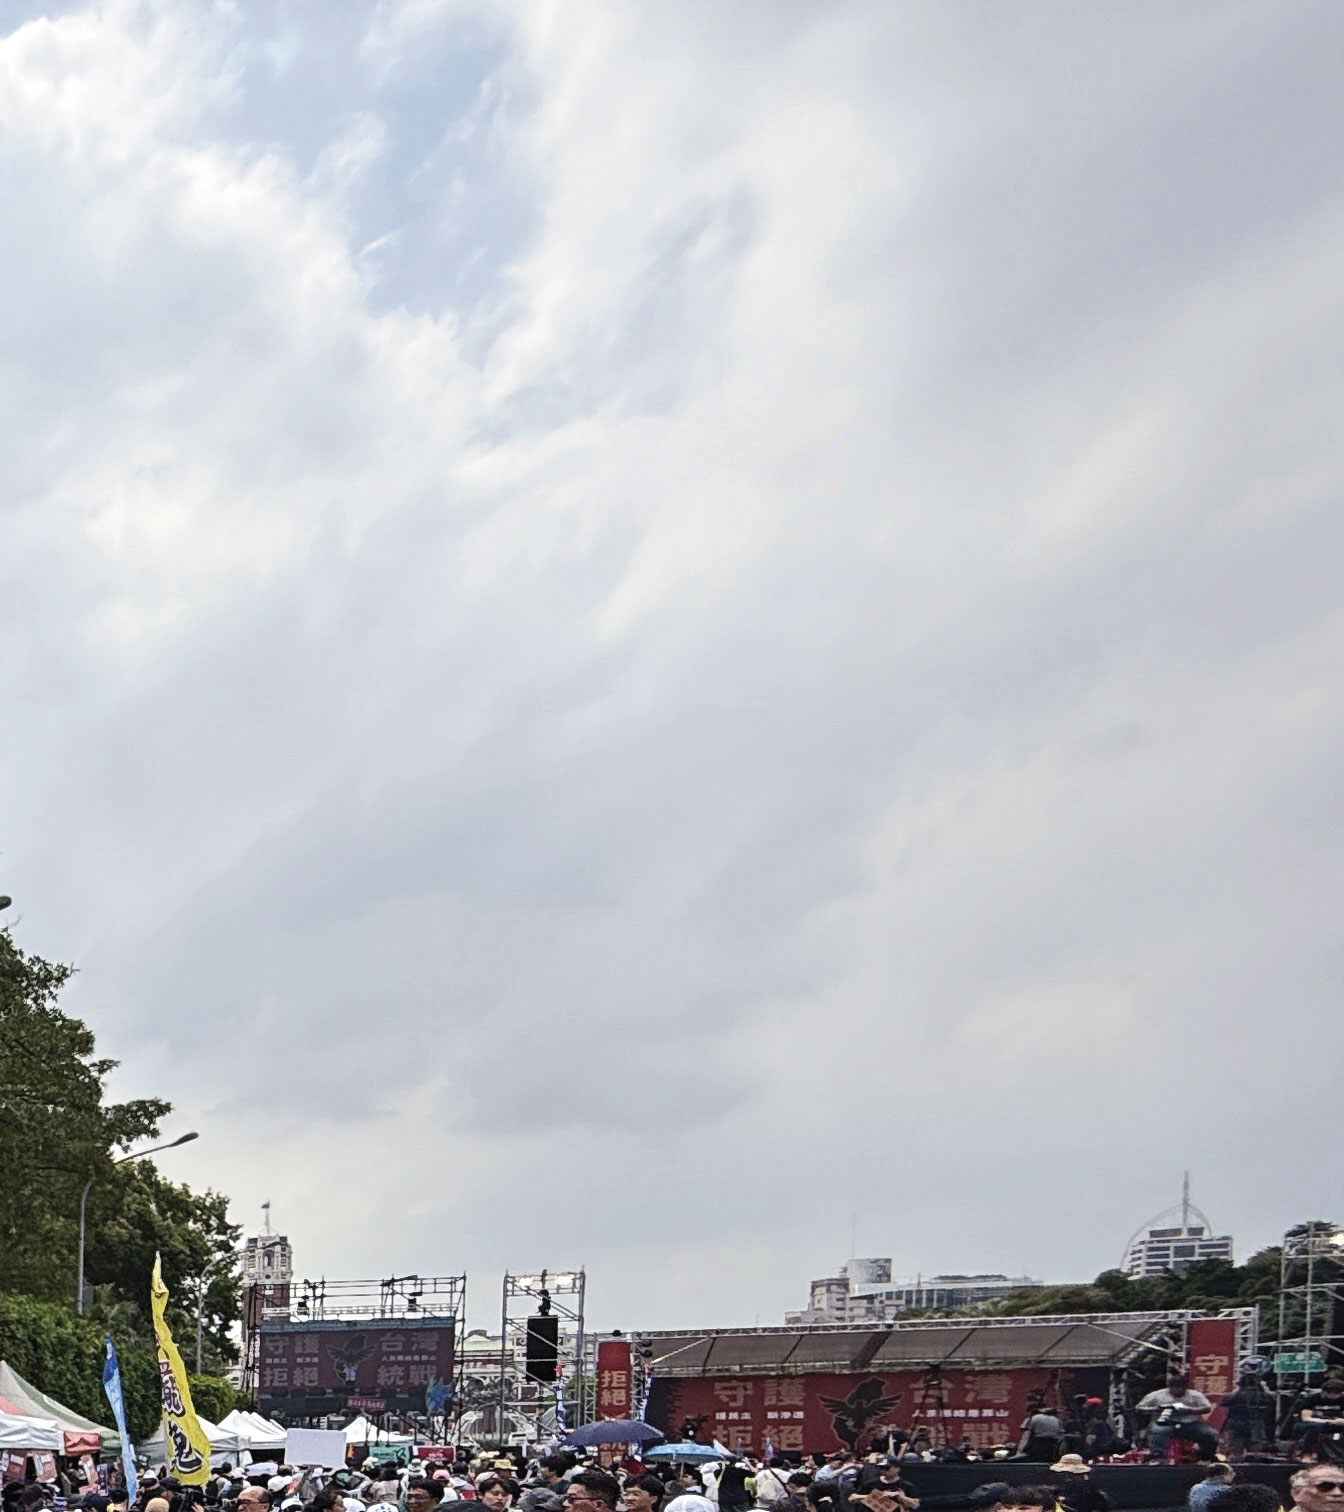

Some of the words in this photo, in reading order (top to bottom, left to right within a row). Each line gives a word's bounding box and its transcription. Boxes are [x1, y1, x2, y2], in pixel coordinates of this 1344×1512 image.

[601, 1370, 627, 1406] 拒絕
[713, 1378, 805, 1406] 守護
[712, 1425, 804, 1451] 拒絕
